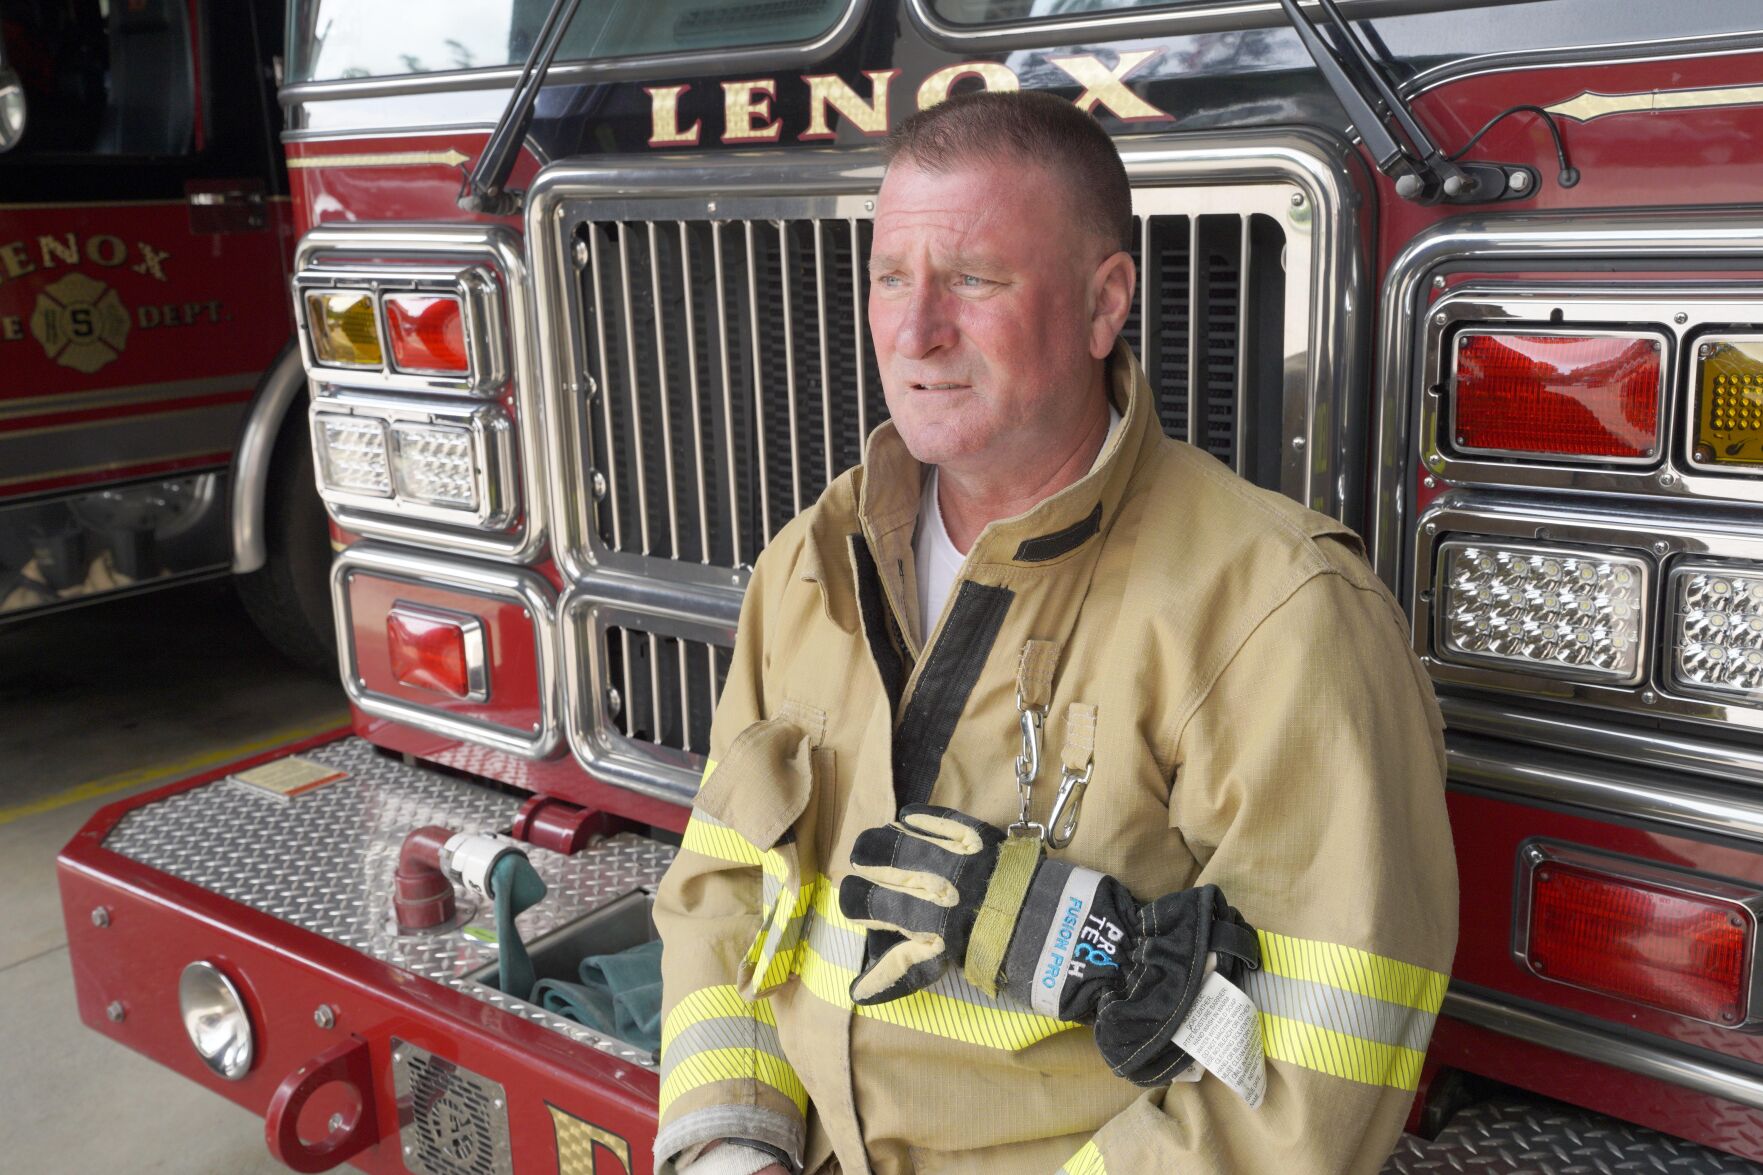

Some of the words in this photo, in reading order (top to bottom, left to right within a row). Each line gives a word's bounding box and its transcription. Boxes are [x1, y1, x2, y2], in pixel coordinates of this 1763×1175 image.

[0, 232, 170, 283] ENOX
[1054, 896, 1083, 951] FUSION
[1042, 952, 1064, 989] PRO
